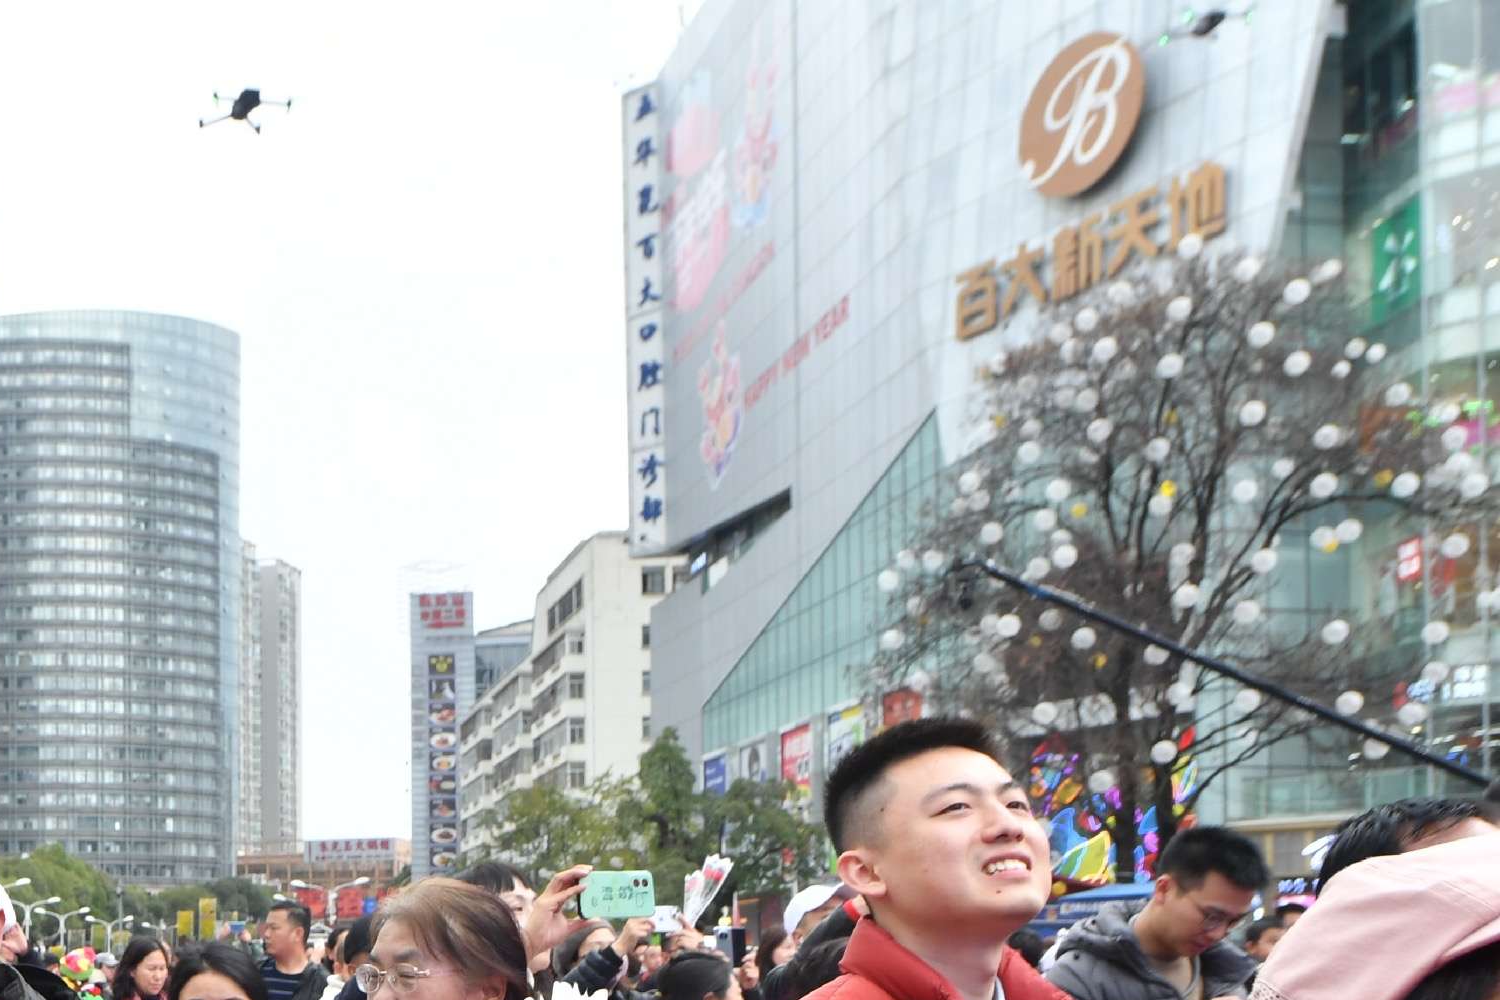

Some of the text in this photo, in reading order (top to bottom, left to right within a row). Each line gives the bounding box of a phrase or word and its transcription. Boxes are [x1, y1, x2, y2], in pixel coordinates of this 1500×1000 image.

[955, 160, 1227, 342] 百大新天地
